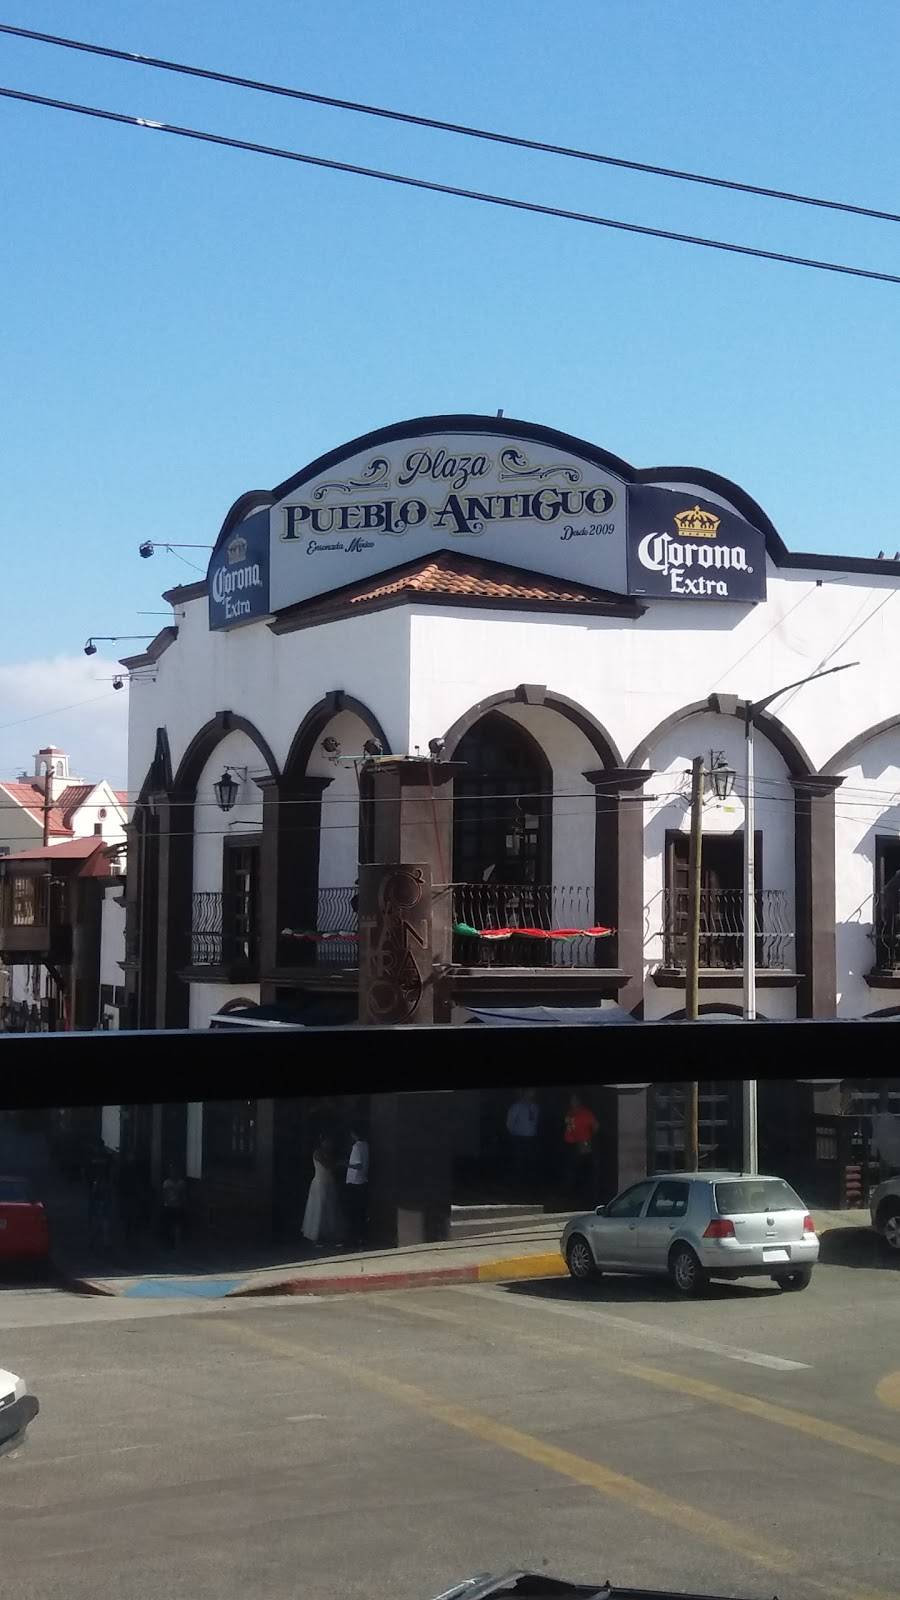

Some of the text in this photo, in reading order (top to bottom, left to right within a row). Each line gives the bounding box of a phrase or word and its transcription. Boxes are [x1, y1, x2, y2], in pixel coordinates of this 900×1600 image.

[398, 449, 491, 490] Plaza
[281, 488, 615, 540] PUEBLO ANTIGUO
[589, 523, 616, 536] 2009
[638, 531, 749, 576] Corona
[212, 563, 261, 605] Corona
[670, 568, 729, 596] Extra
[225, 596, 251, 619] Extra
